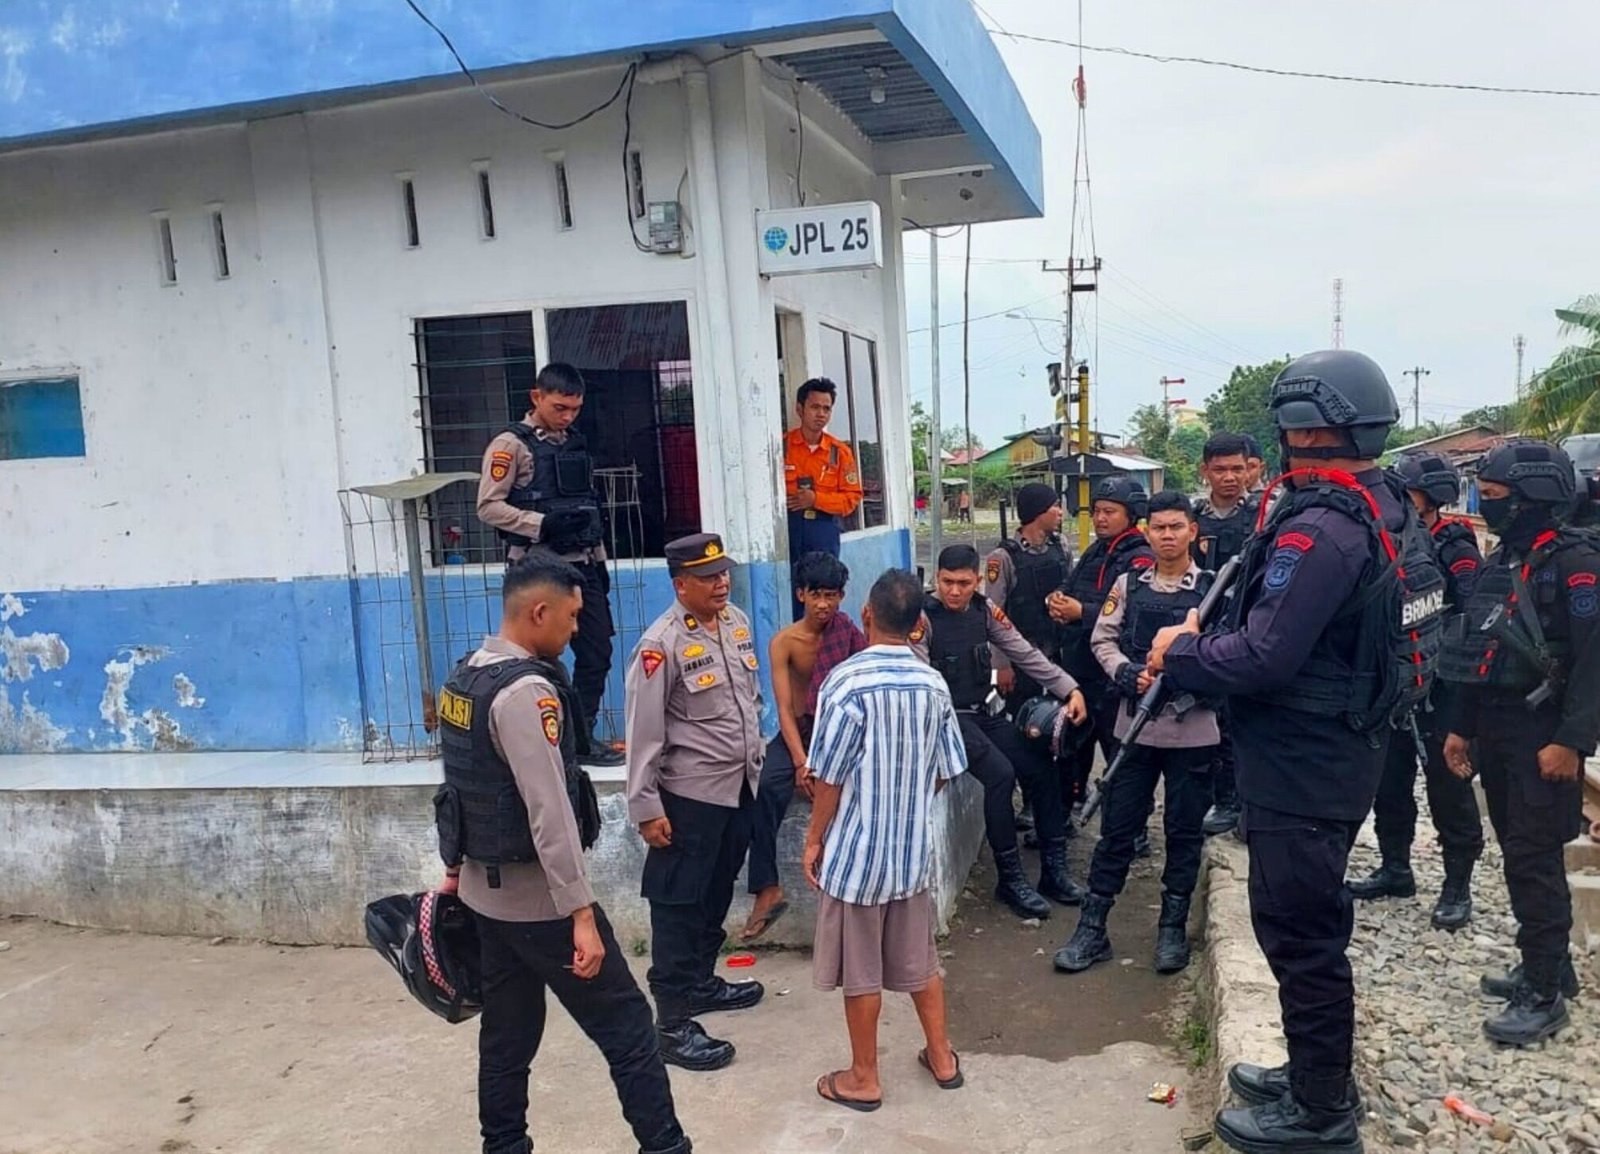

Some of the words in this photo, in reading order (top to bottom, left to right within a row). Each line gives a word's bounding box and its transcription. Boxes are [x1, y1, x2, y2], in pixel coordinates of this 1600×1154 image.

[789, 221, 835, 256] JPL
[841, 218, 869, 251] 25
[1402, 589, 1444, 625] BRIMOB
